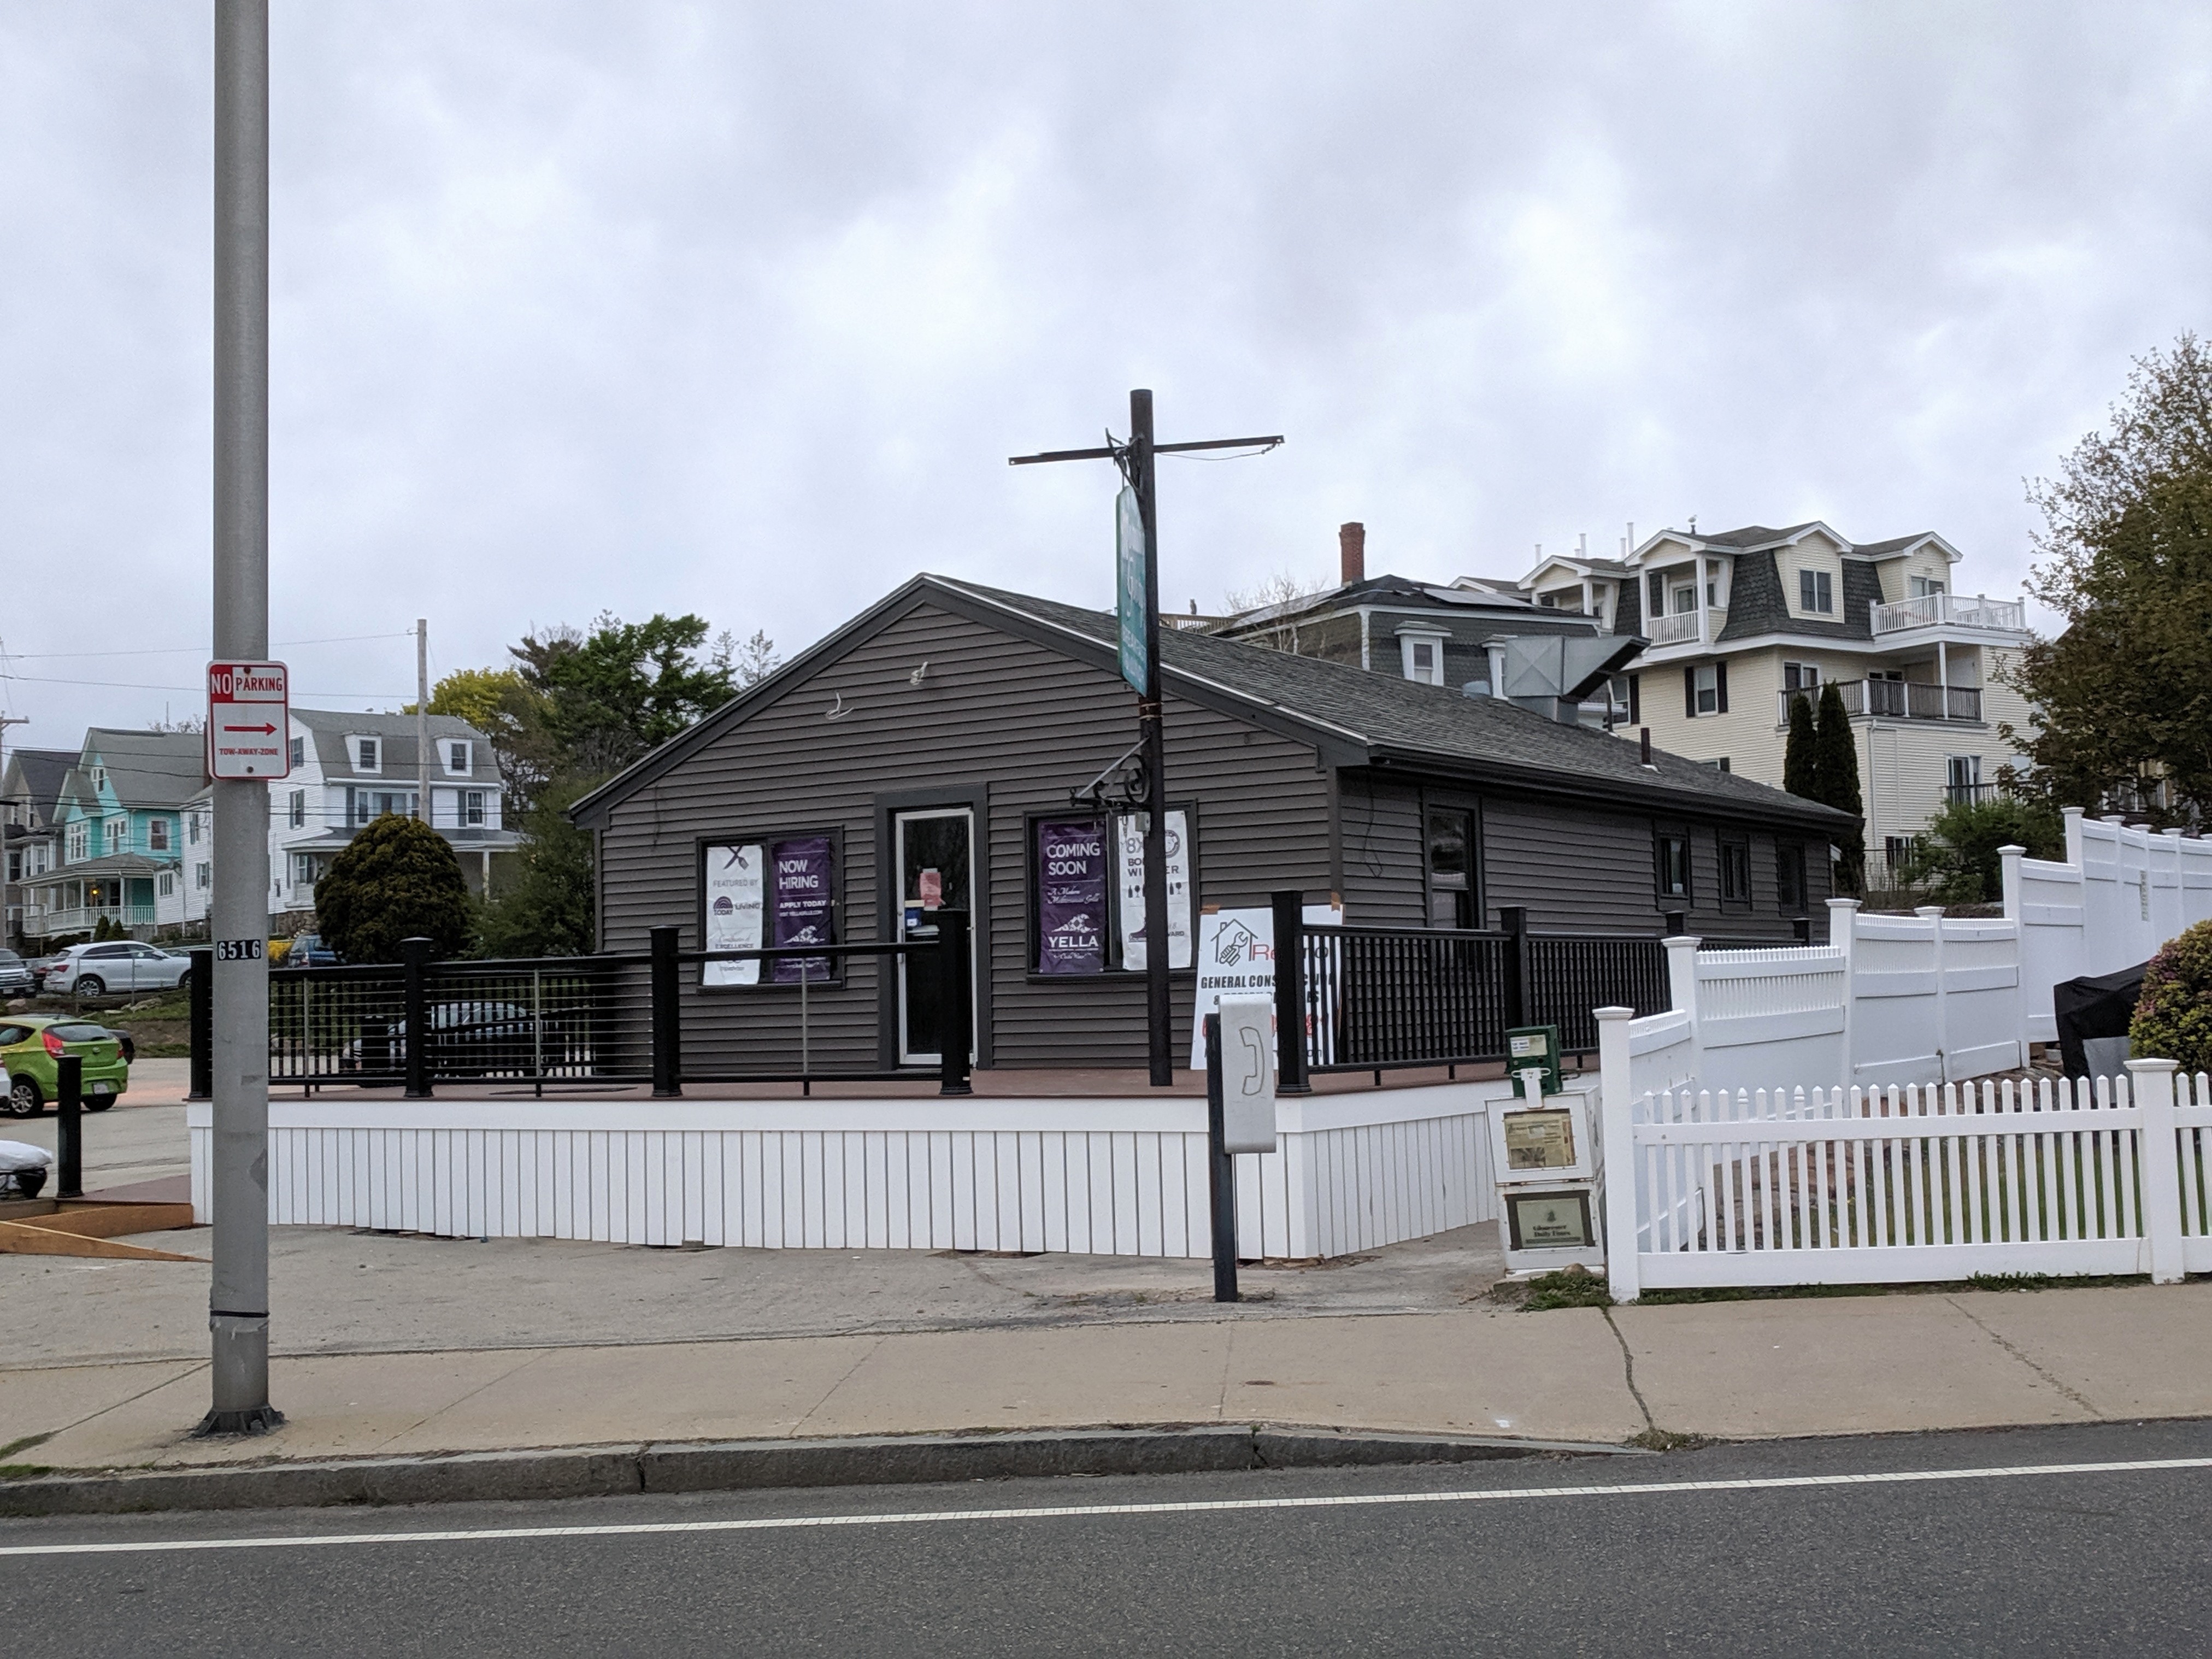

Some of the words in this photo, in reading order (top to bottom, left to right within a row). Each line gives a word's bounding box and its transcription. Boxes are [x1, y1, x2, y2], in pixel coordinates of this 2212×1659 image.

[211, 673, 232, 695] NO
[236, 677, 283, 691] PARKING
[219, 748, 278, 756] TOW-AWAY-ZONE
[1046, 842, 1101, 858] COMING
[779, 859, 808, 874] NOW
[1048, 860, 1087, 876] SOON
[713, 878, 748, 887] FEATURED
[750, 878, 759, 886] BY
[779, 875, 819, 890] HIRING
[1048, 936, 1099, 948] YELLA
[219, 940, 260, 960] 6516
[1201, 975, 1246, 989] GENERAL
